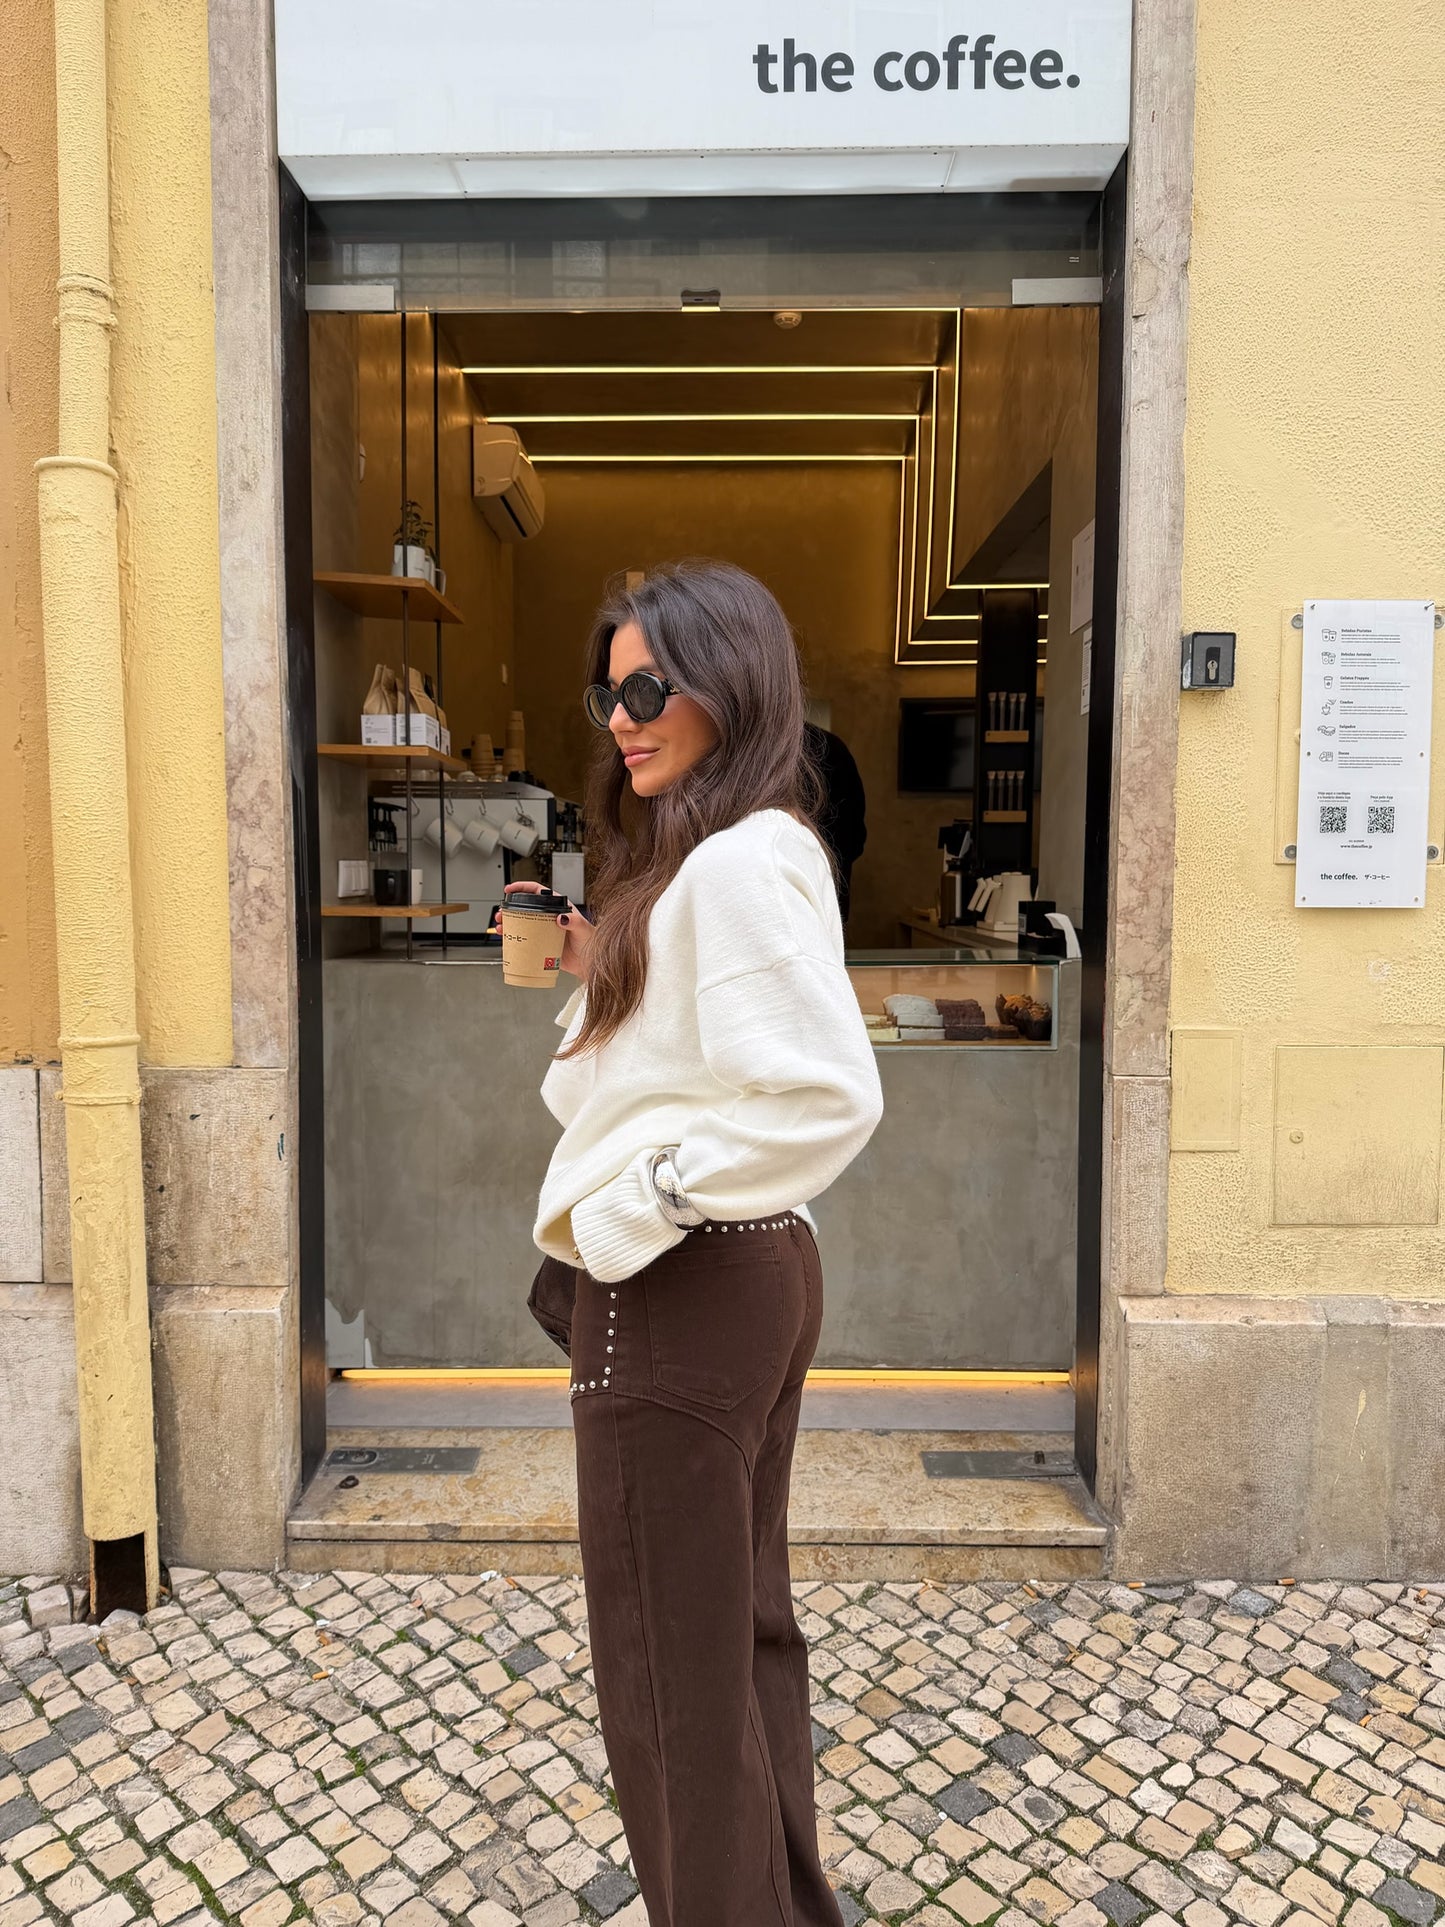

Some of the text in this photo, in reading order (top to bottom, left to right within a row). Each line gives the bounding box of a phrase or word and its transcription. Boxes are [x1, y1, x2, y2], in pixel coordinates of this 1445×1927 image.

[752, 34, 1080, 94] the coffee.
[1320, 872, 1358, 880] the coffee.
